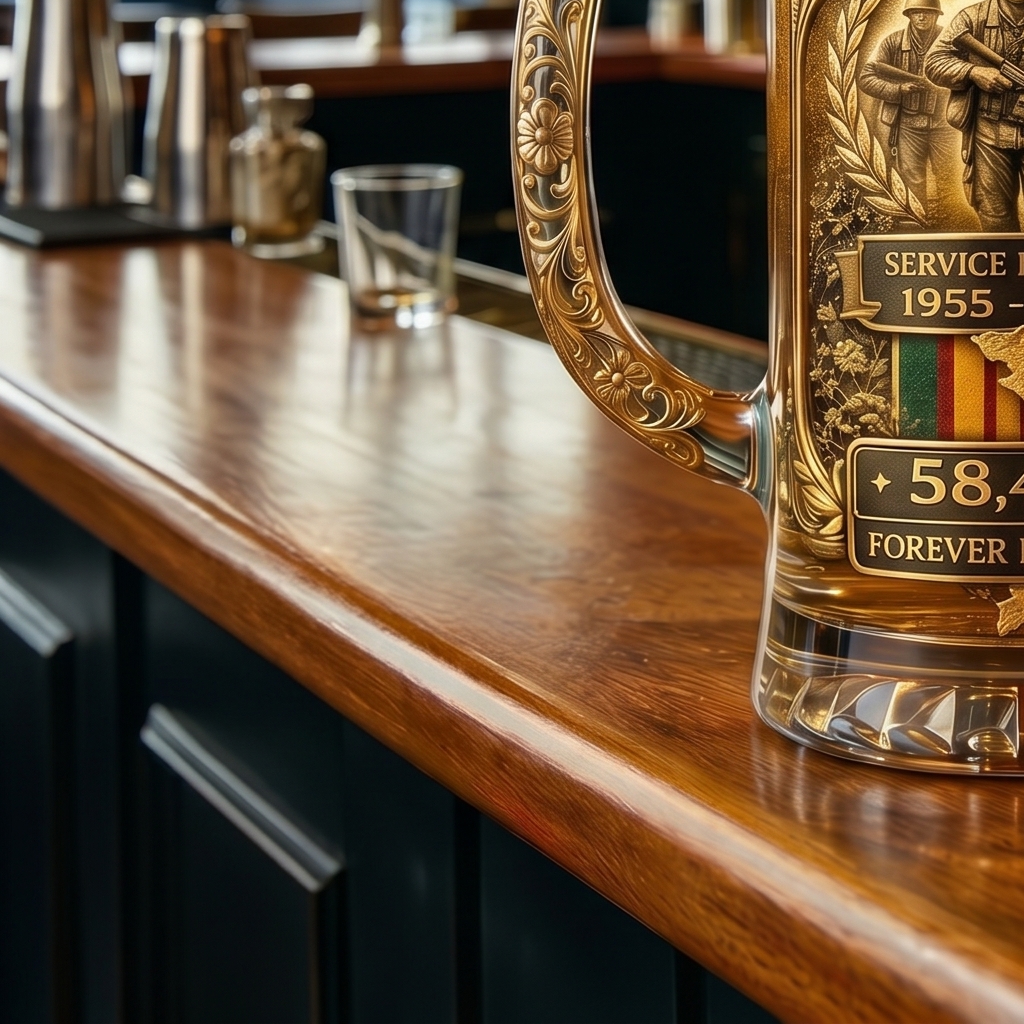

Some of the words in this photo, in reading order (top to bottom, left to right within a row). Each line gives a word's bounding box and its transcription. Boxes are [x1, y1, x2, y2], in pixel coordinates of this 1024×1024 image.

[884, 252, 1007, 277] SERVICE
[901, 288, 994, 318] 1955
[868, 532, 1009, 564] FOREVER
